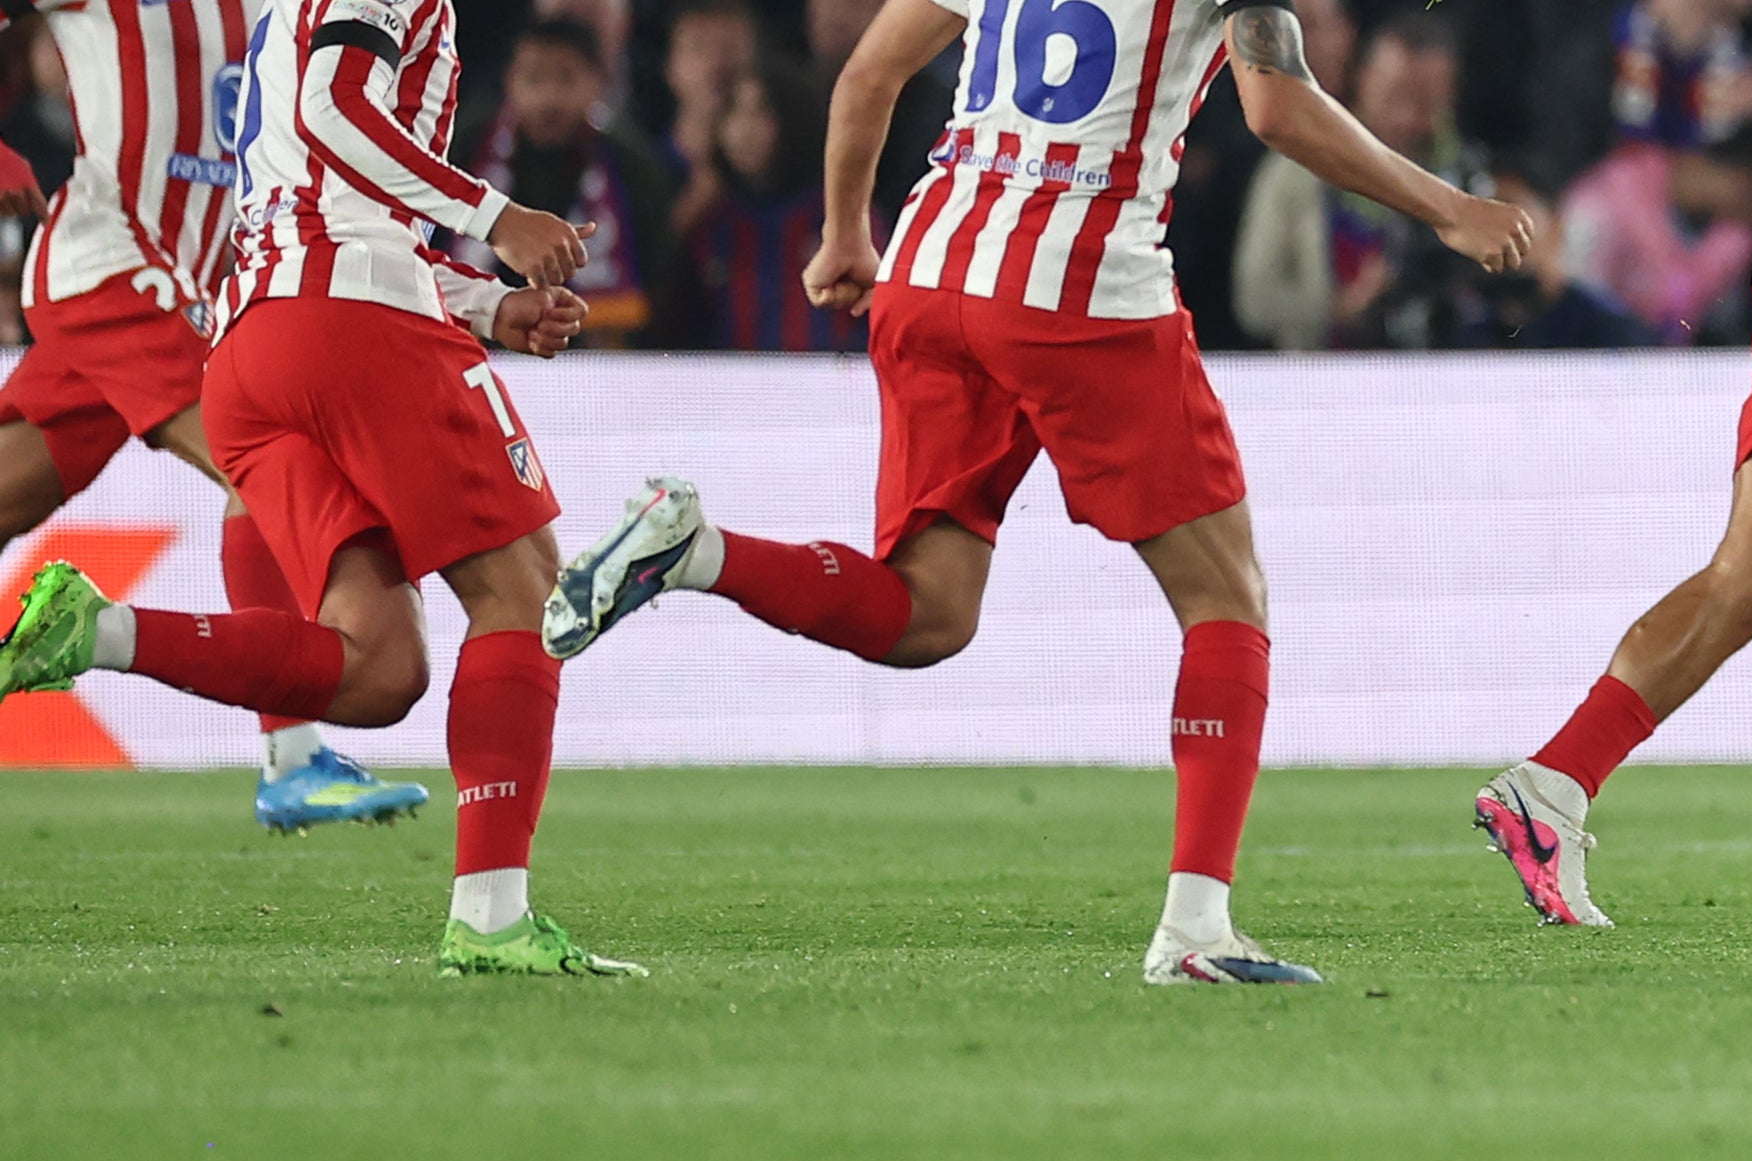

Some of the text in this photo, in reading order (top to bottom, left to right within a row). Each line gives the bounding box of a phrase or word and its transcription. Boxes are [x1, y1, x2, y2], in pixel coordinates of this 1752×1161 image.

[1026, 159, 1111, 186] Children
[1173, 718, 1224, 738] TLETI
[457, 781, 517, 808] ATLETI
